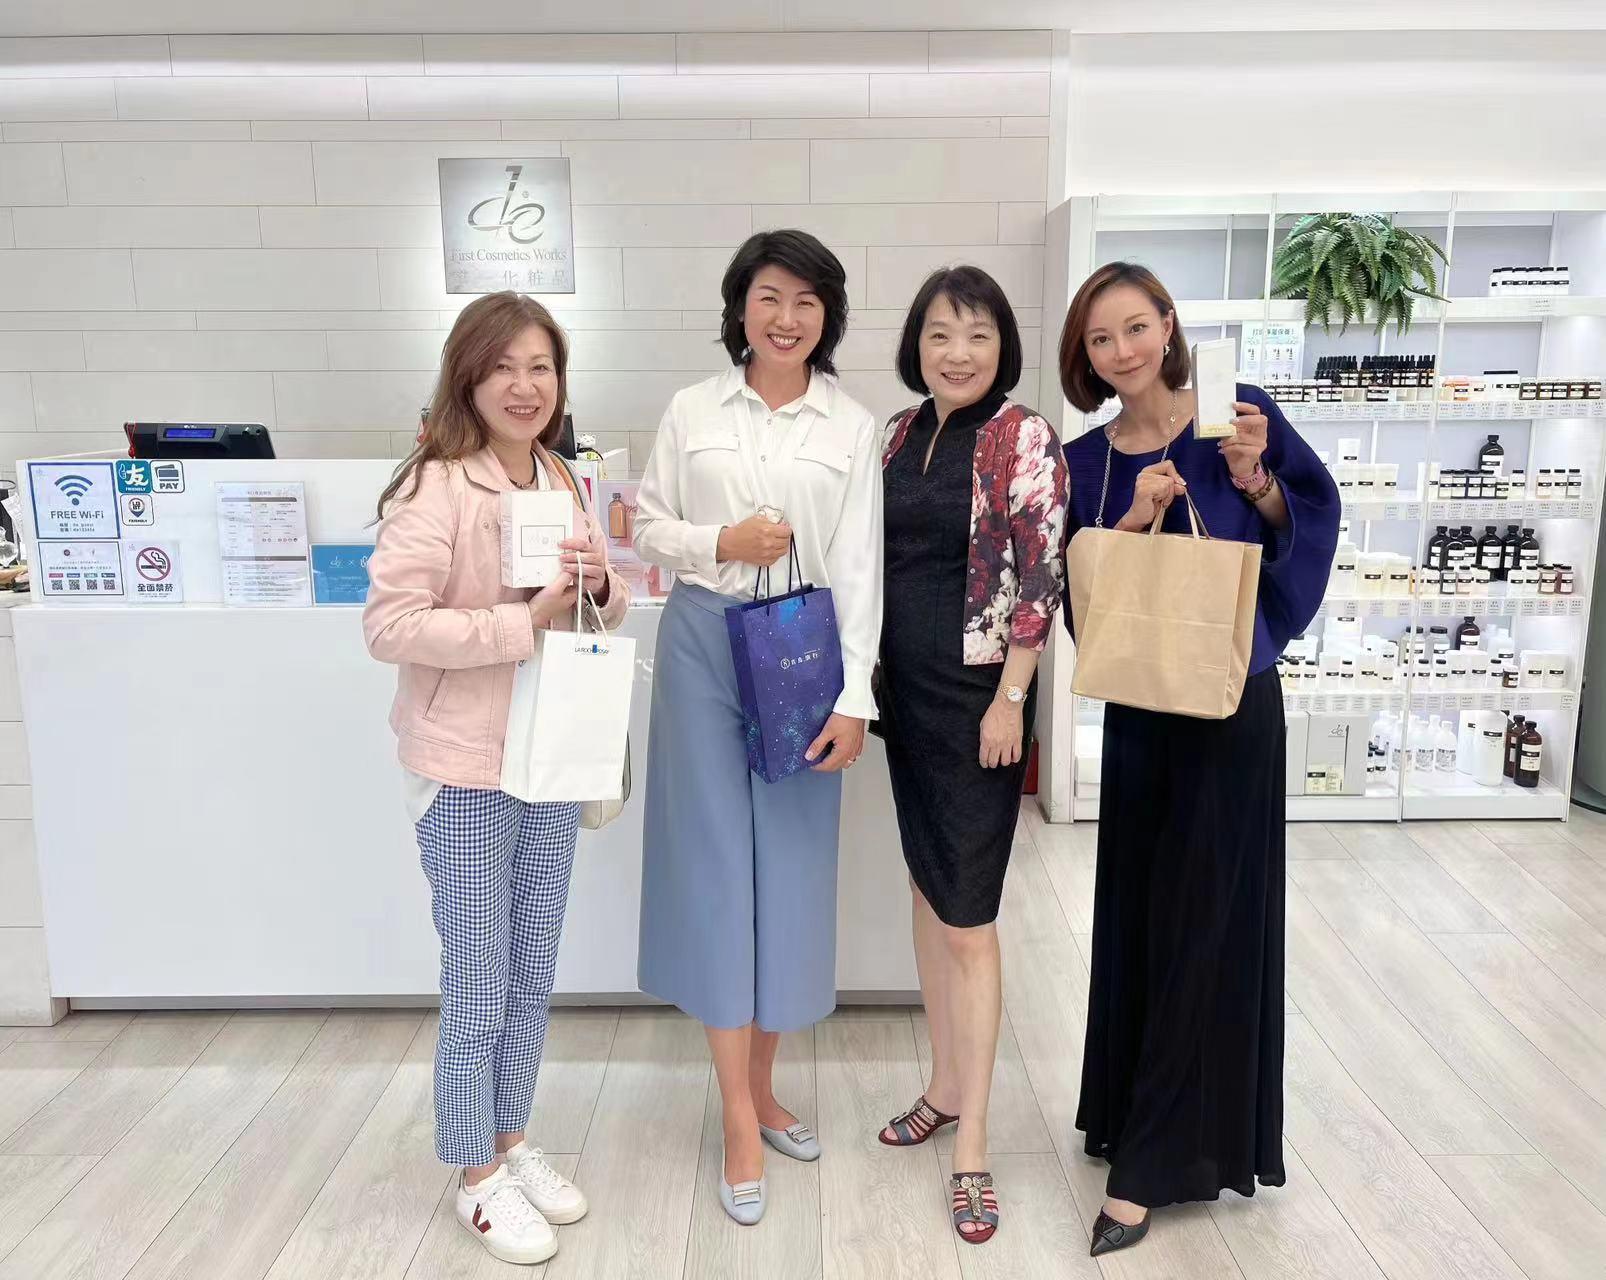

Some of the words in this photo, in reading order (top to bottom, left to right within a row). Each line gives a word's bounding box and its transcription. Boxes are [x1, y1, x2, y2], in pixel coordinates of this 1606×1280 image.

[450, 247, 475, 261] First
[476, 248, 532, 261] Cosmetics
[533, 248, 568, 261] Works
[125, 463, 149, 486] 友
[159, 482, 179, 490] PAY
[50, 510, 77, 519] FREE
[79, 510, 104, 519] Wi-Fi
[137, 583, 174, 592] 全面禁菸
